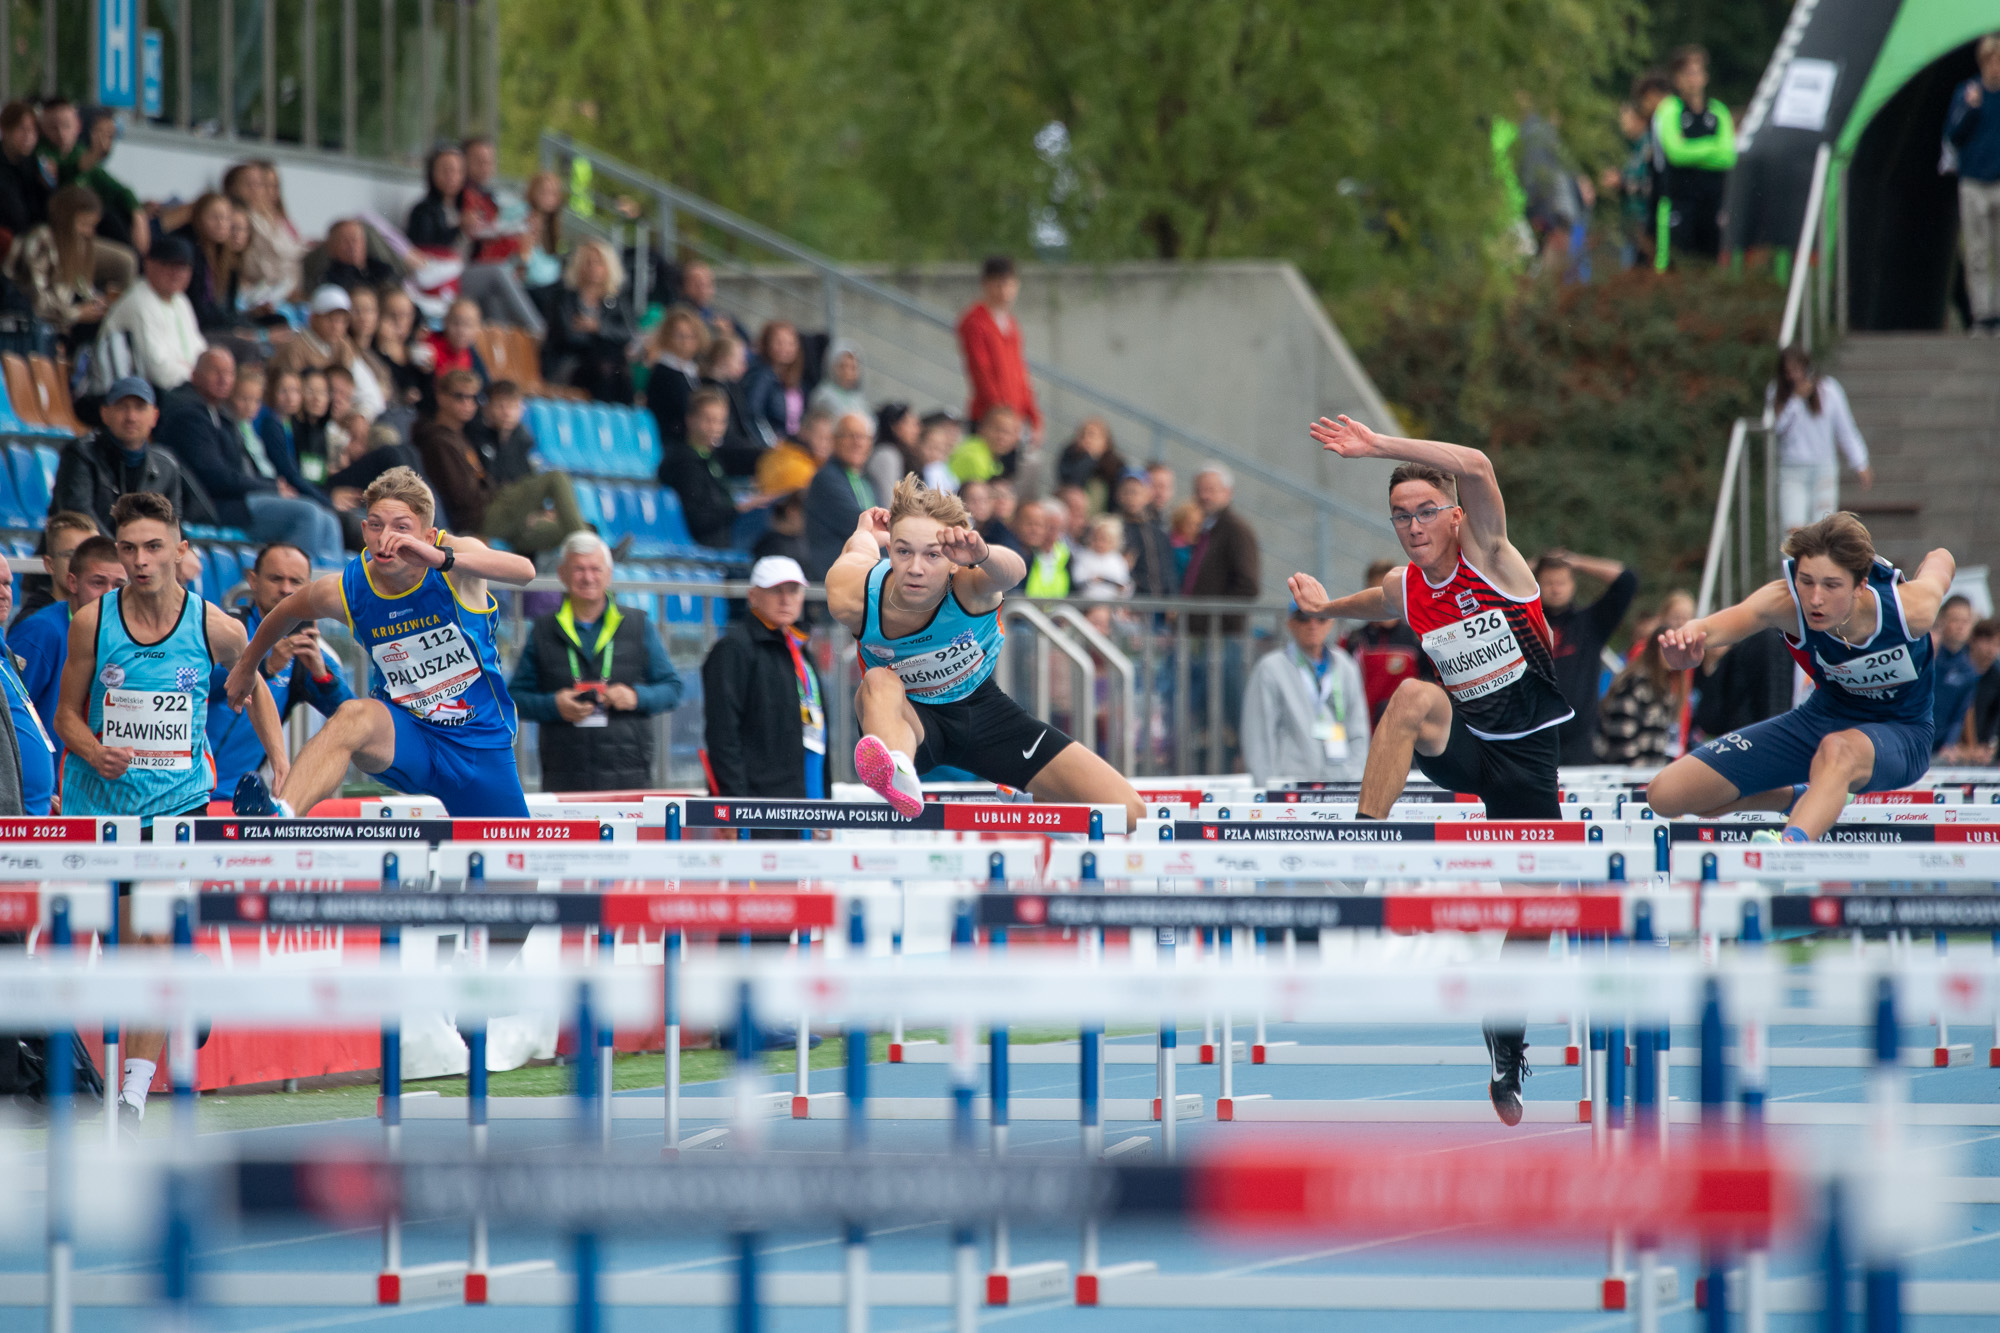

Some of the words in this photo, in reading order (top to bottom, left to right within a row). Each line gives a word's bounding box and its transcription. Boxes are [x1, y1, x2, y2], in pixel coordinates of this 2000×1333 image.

[372, 614, 441, 638] KRUSZWICA
[1463, 612, 1502, 639] 526
[418, 628, 457, 651] 112
[384, 653, 408, 662] ORLEN
[935, 642, 972, 662] 920
[1437, 635, 1517, 677] MIKUŚKIEWICZ
[1865, 648, 1904, 670] 200
[387, 647, 471, 687] PALUSZAK
[899, 650, 980, 684] KUŚMIEREK
[1459, 683, 1490, 699] LUBLIN
[1491, 671, 1516, 687] 2022
[153, 695, 187, 711] 922
[410, 692, 443, 710] LUBLIN
[444, 681, 468, 697] 2022
[106, 720, 187, 741] PŁAWIŃSKI
[151, 758, 176, 767] 2022
[735, 808, 762, 820] PZLA
[766, 809, 845, 821] MISTRZOSTWA
[849, 811, 887, 822] POLSKI
[974, 812, 1021, 824] LUBLIN
[1028, 812, 1061, 825] 2022
[1895, 812, 1929, 822] polanik
[33, 826, 67, 838] 2022
[244, 826, 271, 838] PZLA
[274, 826, 353, 838] MISTRZOSTWA
[357, 827, 396, 838] POLSKI
[399, 827, 421, 838] U16
[483, 827, 530, 839] LUBLIN
[537, 827, 570, 839] 2022
[1224, 829, 1251, 840] PZLA
[1254, 829, 1334, 841] MISTRZOSTWA
[1338, 829, 1378, 841] POLSKI
[1381, 829, 1402, 841] U16
[1466, 829, 1514, 841] LUBLIN
[1521, 829, 1555, 841] 2022
[1720, 831, 1748, 843] PZLA
[1836, 831, 1877, 843] POLSKI
[1880, 831, 1902, 843] U16
